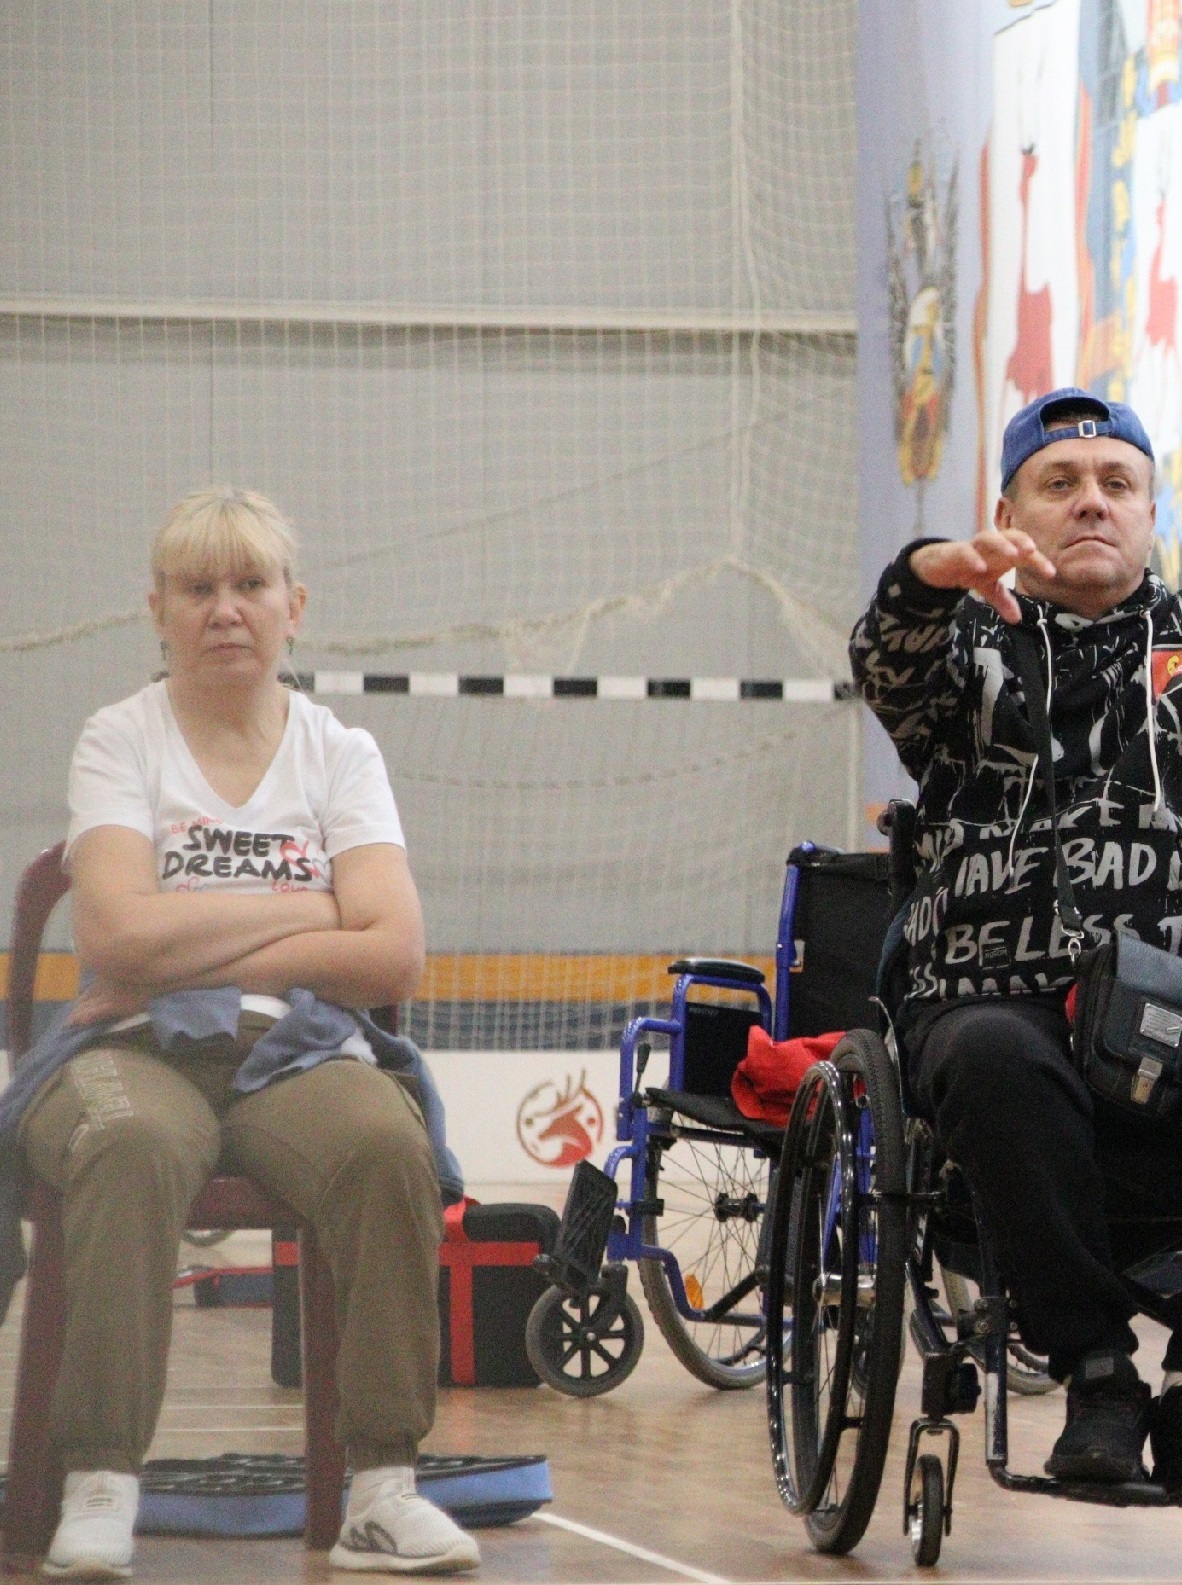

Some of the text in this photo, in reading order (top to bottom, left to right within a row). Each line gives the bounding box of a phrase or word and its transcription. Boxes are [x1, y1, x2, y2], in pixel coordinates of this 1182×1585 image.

[183, 824, 295, 857] SWEET
[162, 850, 314, 882] DREAMS
[1053, 837, 1157, 890] BAD
